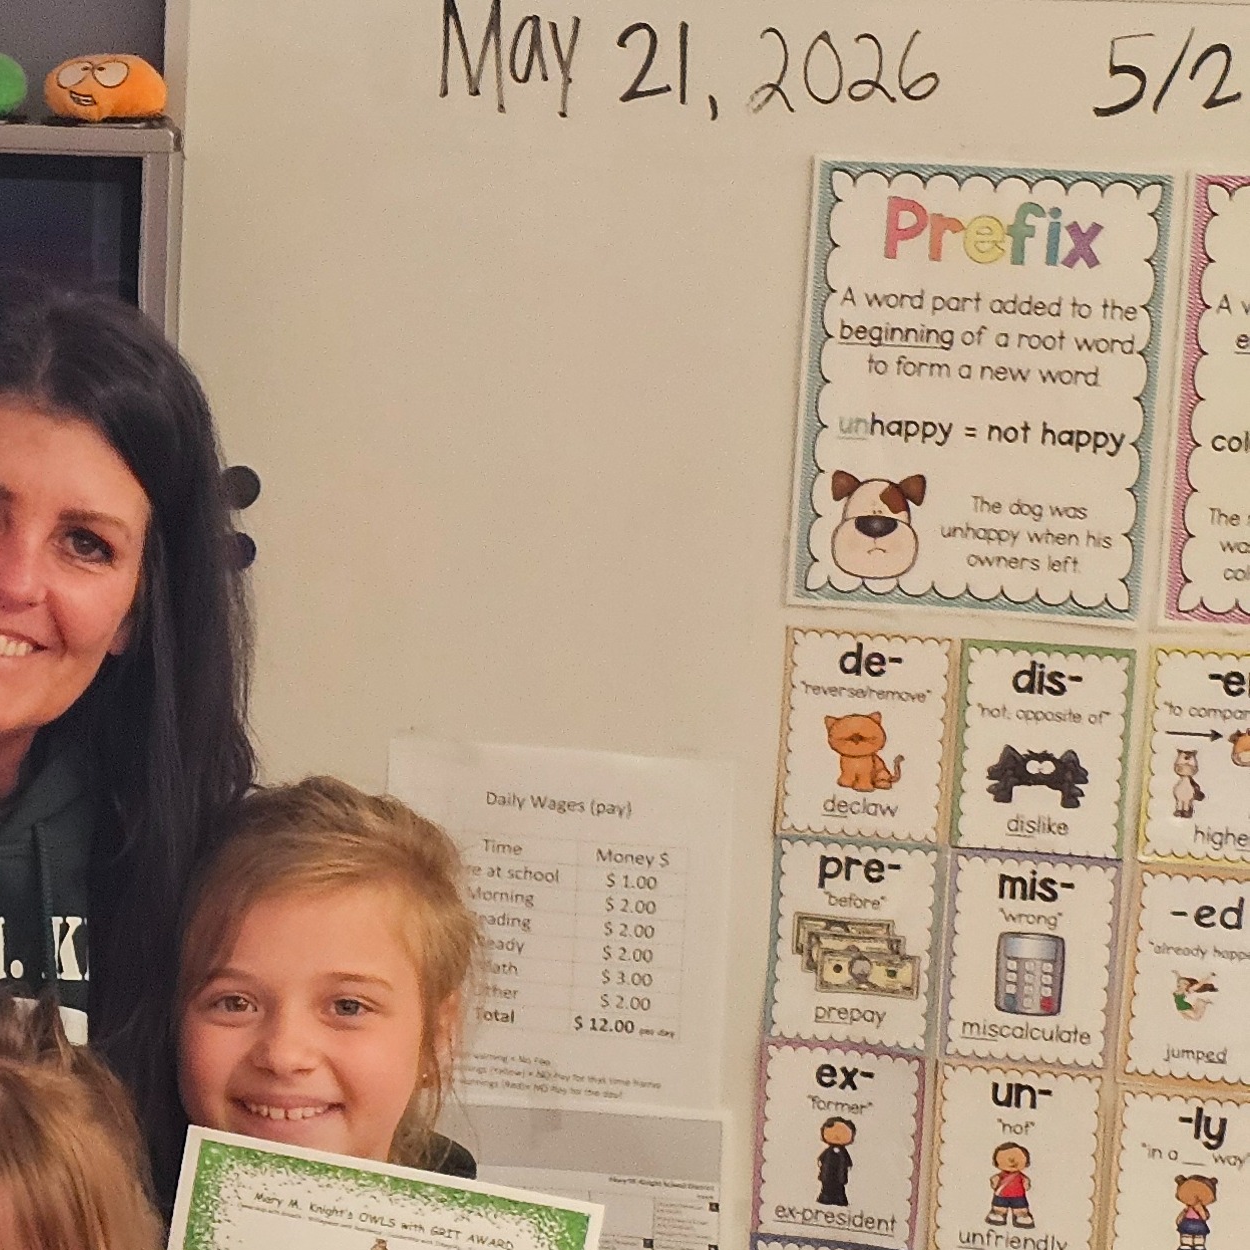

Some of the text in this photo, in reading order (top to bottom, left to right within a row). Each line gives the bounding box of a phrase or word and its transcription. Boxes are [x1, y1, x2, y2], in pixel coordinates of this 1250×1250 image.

[439, 0, 940, 120] May 21, 2026
[883, 195, 1104, 270] Prefix
[840, 288, 1137, 321] A word part added to the
[1216, 294, 1232, 315] A
[838, 321, 954, 350] beginning
[961, 325, 988, 346] of
[995, 333, 1010, 347] a
[1017, 330, 1066, 351] root
[867, 353, 888, 376] to
[896, 355, 951, 377] form
[958, 364, 972, 379] a
[980, 366, 1031, 382] new
[839, 413, 953, 446] unhappy
[988, 421, 1031, 444] not
[1041, 422, 1126, 454] happy
[971, 495, 1088, 521] The dog was
[1209, 507, 1240, 527] The
[941, 522, 1113, 550] unhappy when his
[966, 554, 1041, 571] owners
[839, 641, 903, 677] de-
[1012, 660, 1083, 696] dis-
[1208, 670, 1250, 697] -e
[486, 791, 632, 817] Daily Wages (pay)
[822, 795, 898, 819] declaw
[1007, 816, 1069, 836] dislike
[482, 838, 523, 856] Time
[596, 849, 669, 868] Money $
[487, 866, 559, 884] at school
[605, 874, 658, 890] $ 1.00
[818, 849, 901, 889] pre-
[998, 872, 1075, 903] mis-
[605, 897, 657, 915] $ 2.00
[1171, 898, 1245, 931] -ed
[601, 971, 654, 987] $ 3.00
[475, 1008, 514, 1024] Total
[574, 1015, 583, 1031] $
[590, 1017, 635, 1034] 12.00
[814, 1006, 886, 1028] prepay
[960, 1021, 1091, 1045] miscalculate
[1163, 1048, 1227, 1064] jumped
[815, 1063, 875, 1090] ex-
[991, 1082, 1053, 1110] un-
[1178, 1106, 1227, 1150] -ly
[254, 1192, 284, 1208] Mary
[358, 1212, 396, 1228] OWLS
[401, 1222, 425, 1233] with
[430, 1226, 462, 1240] GRIT
[466, 1234, 516, 1250] AWARD
[775, 1205, 897, 1235] ex-president
